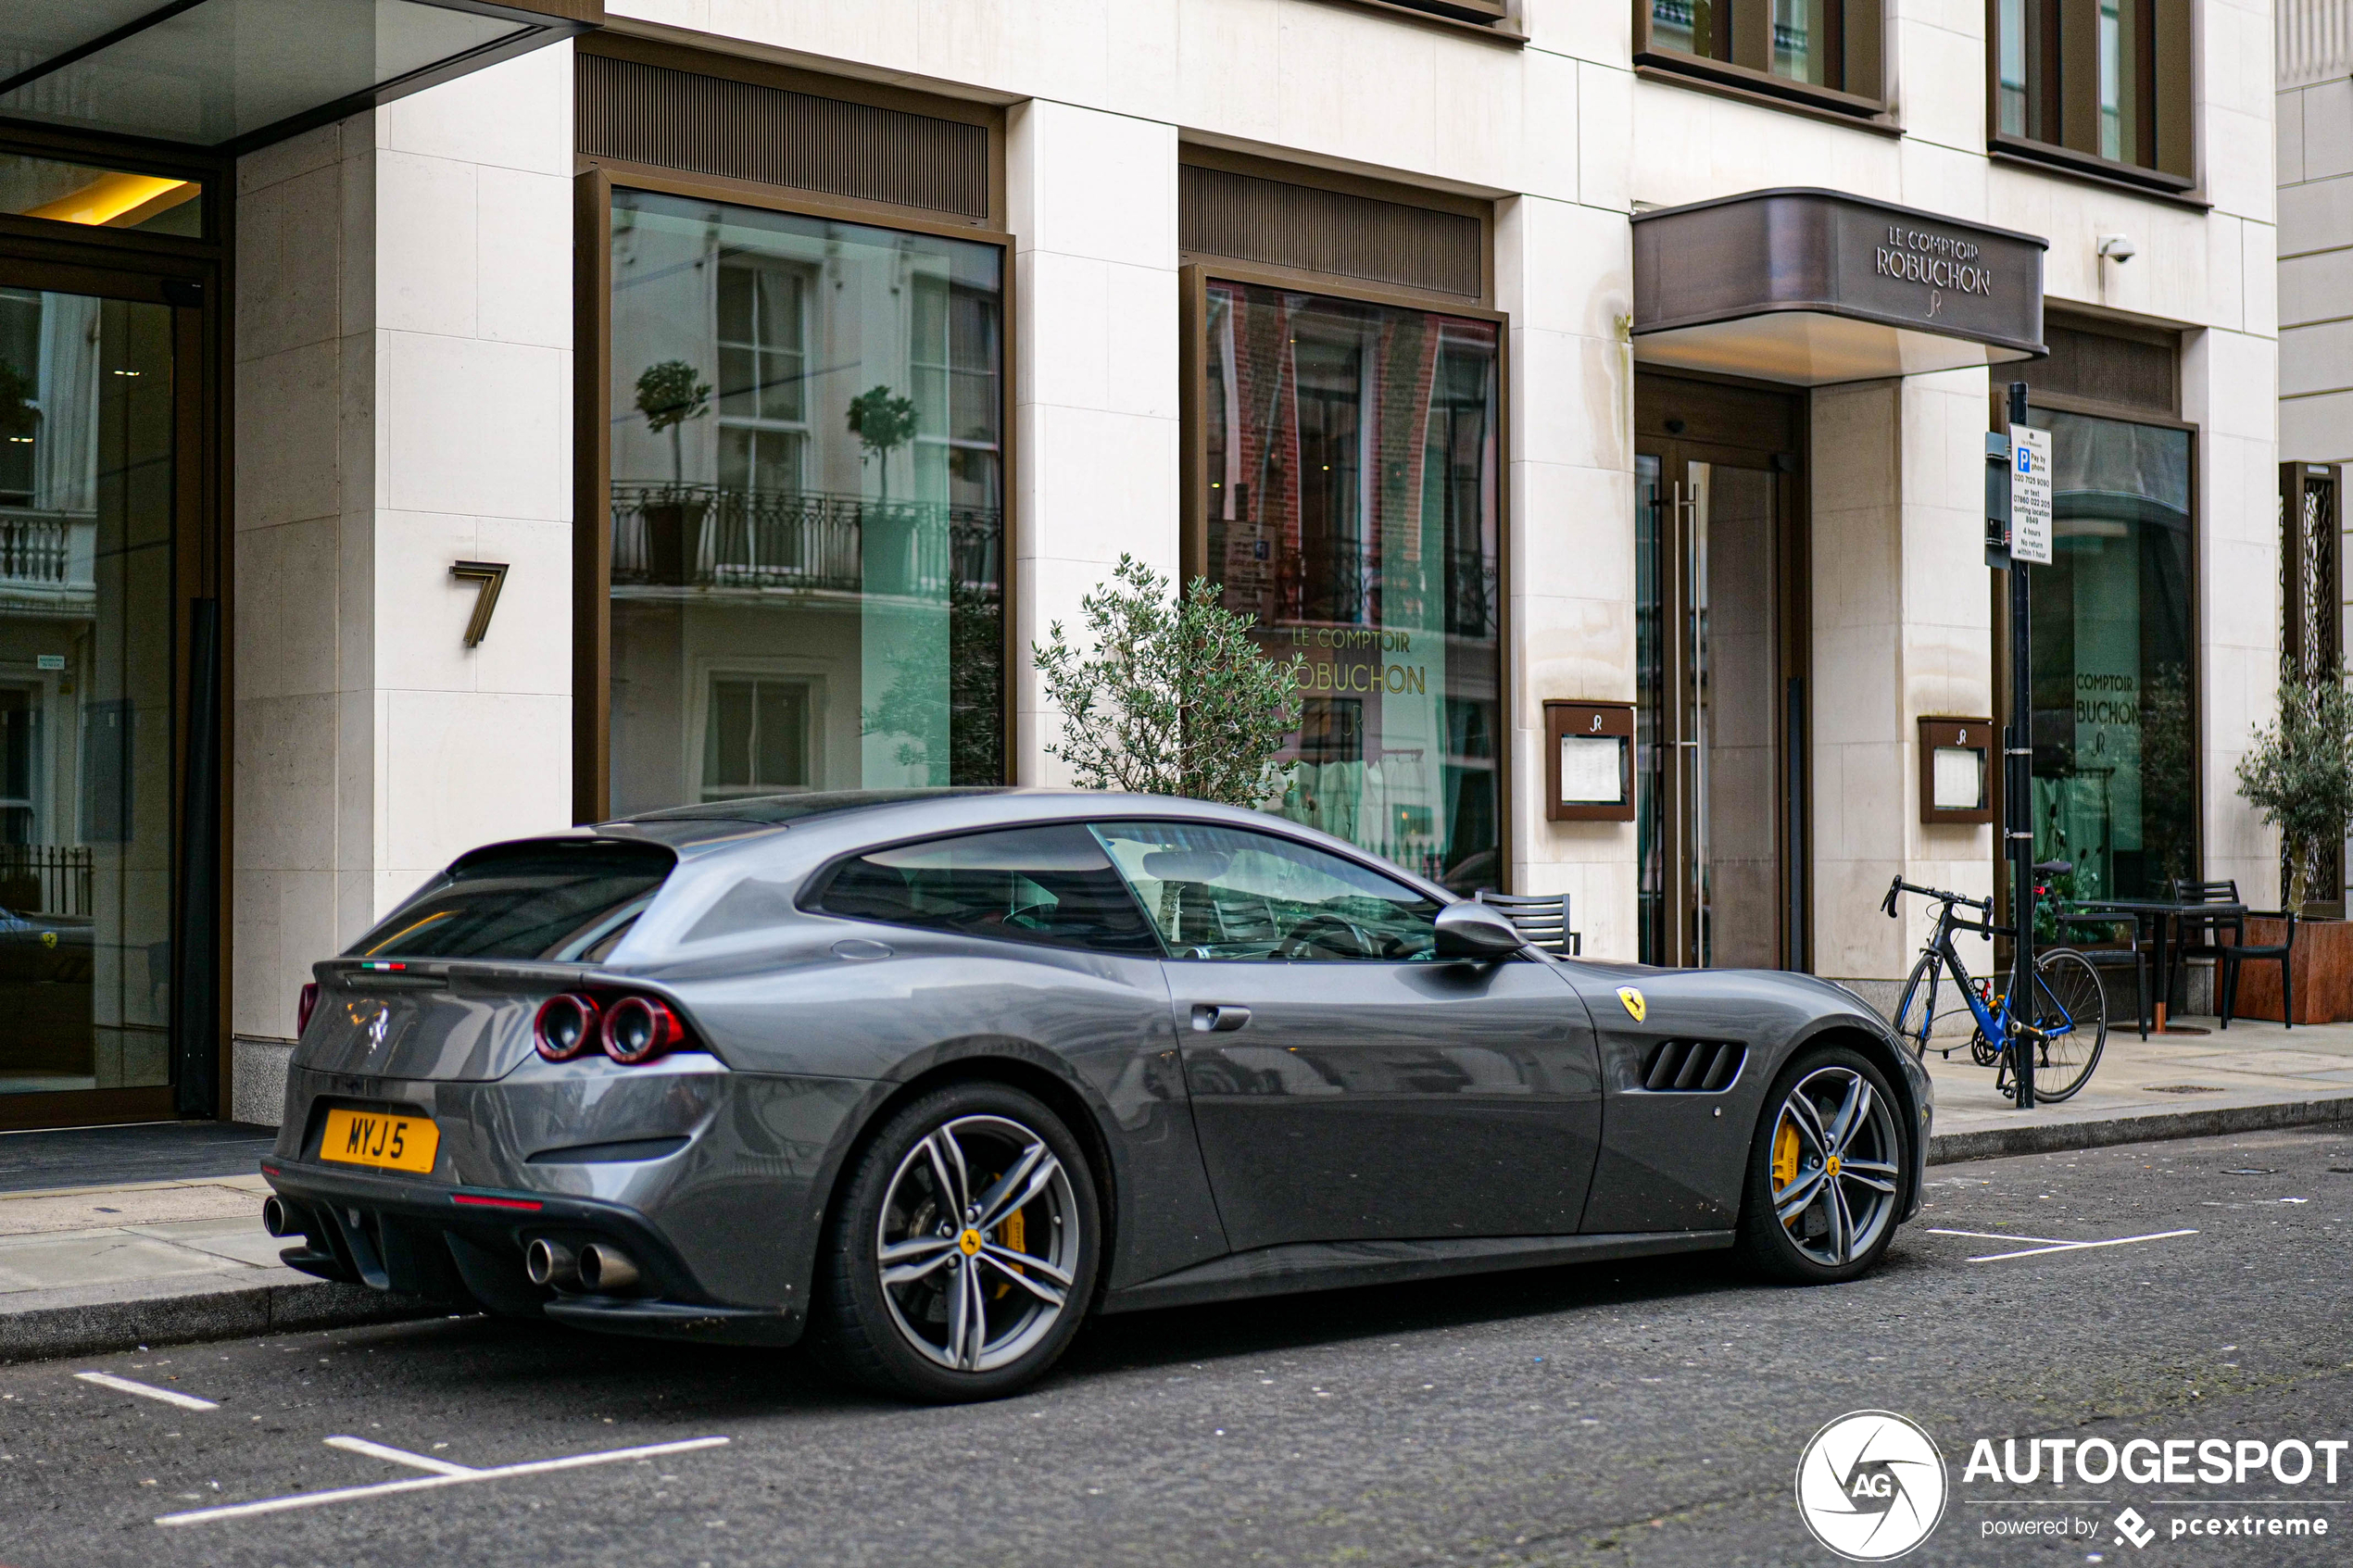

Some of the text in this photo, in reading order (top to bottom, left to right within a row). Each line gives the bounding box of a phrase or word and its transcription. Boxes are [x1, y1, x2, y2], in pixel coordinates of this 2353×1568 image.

[1889, 225, 1980, 263] LE COMPTOIR
[1876, 246, 1991, 296] ROBUCHON
[2020, 450, 2029, 470] P
[2031, 452, 2046, 465] Pay by
[2031, 463, 2045, 472] phone
[2014, 472, 2049, 488] 020 7125 9090
[2030, 489, 2040, 497] text
[2013, 505, 2050, 518] quoting location
[2028, 528, 2041, 537] hours
[2020, 537, 2044, 549] No return
[2018, 547, 2032, 557] within
[2035, 550, 2046, 558] hour
[448, 559, 510, 648] 7
[1292, 626, 1411, 653] LE COMPTOIR
[2076, 673, 2133, 693] COMPTOIR
[1954, 954, 1988, 1012] BOARDMAN
